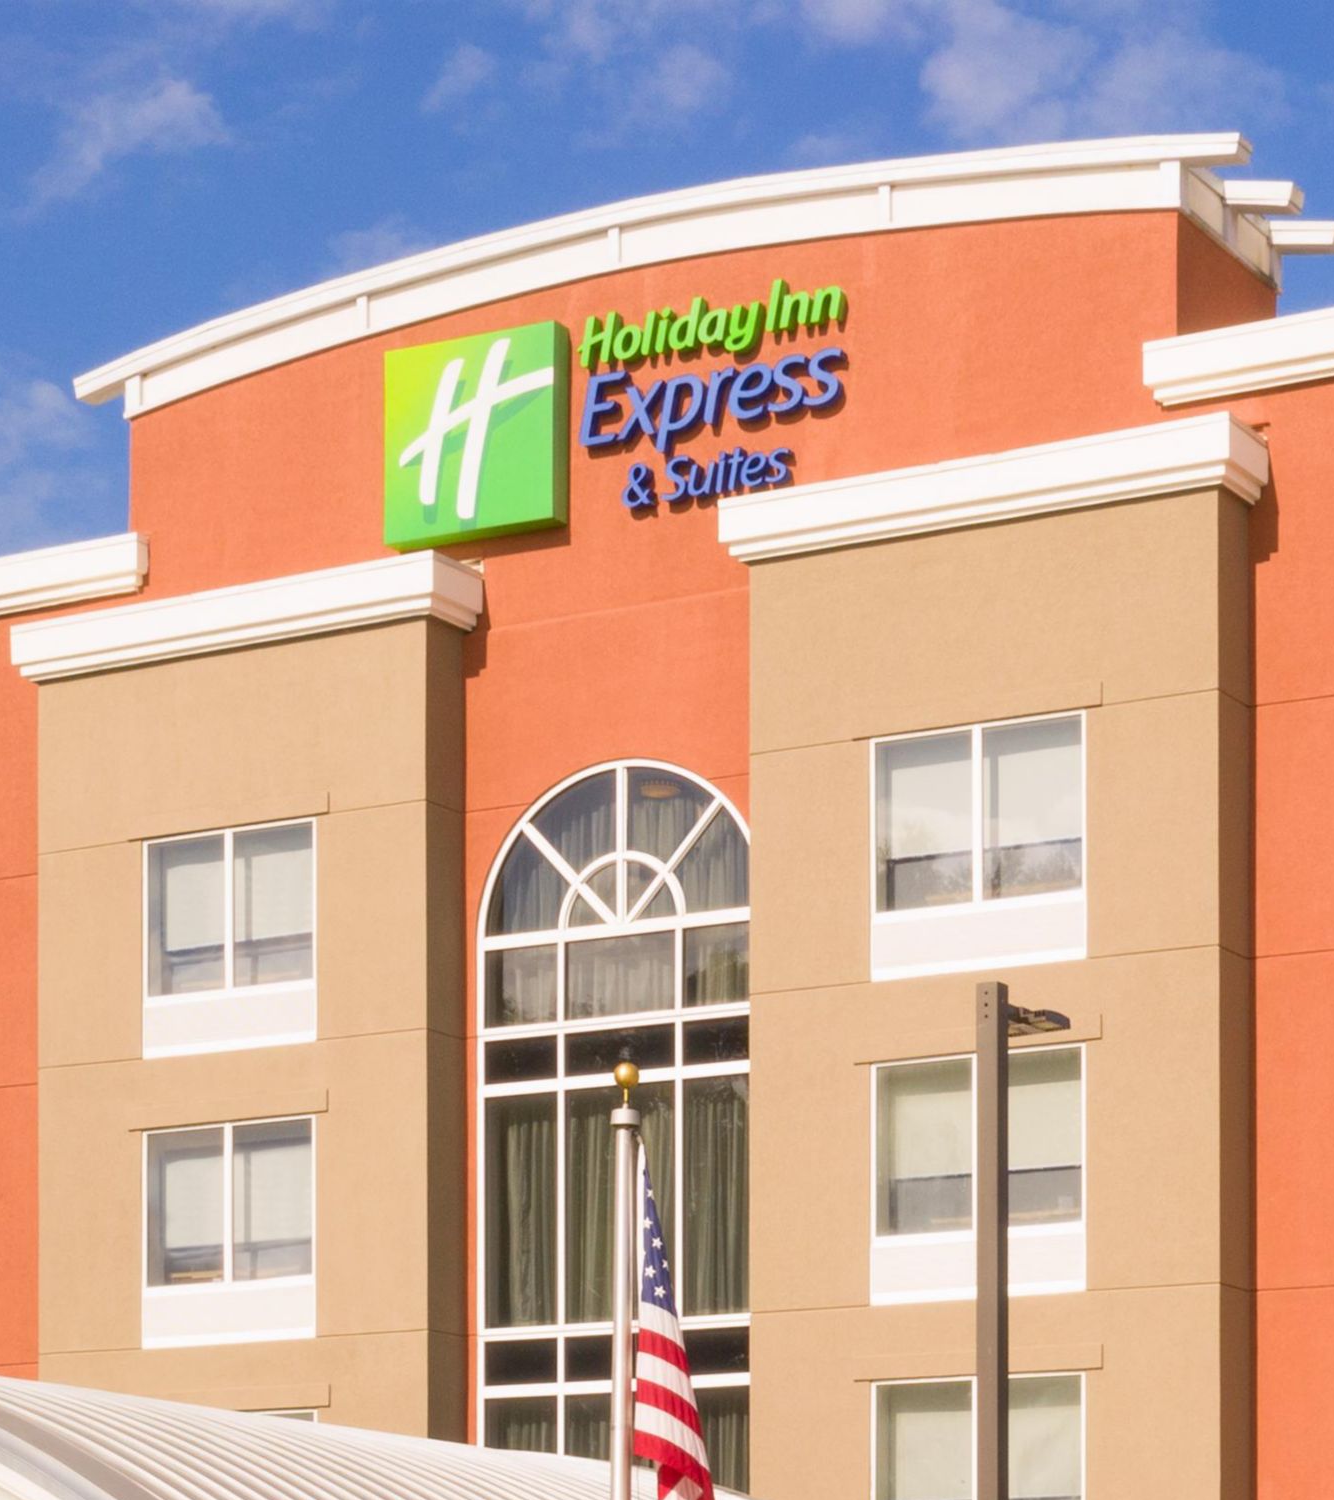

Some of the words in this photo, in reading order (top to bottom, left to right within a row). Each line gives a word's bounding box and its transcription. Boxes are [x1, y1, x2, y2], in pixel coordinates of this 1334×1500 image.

[577, 296, 763, 369] Holiday
[765, 278, 845, 333] Inn
[577, 347, 845, 454] Express
[620, 462, 657, 509] &
[659, 446, 794, 503] Suites
